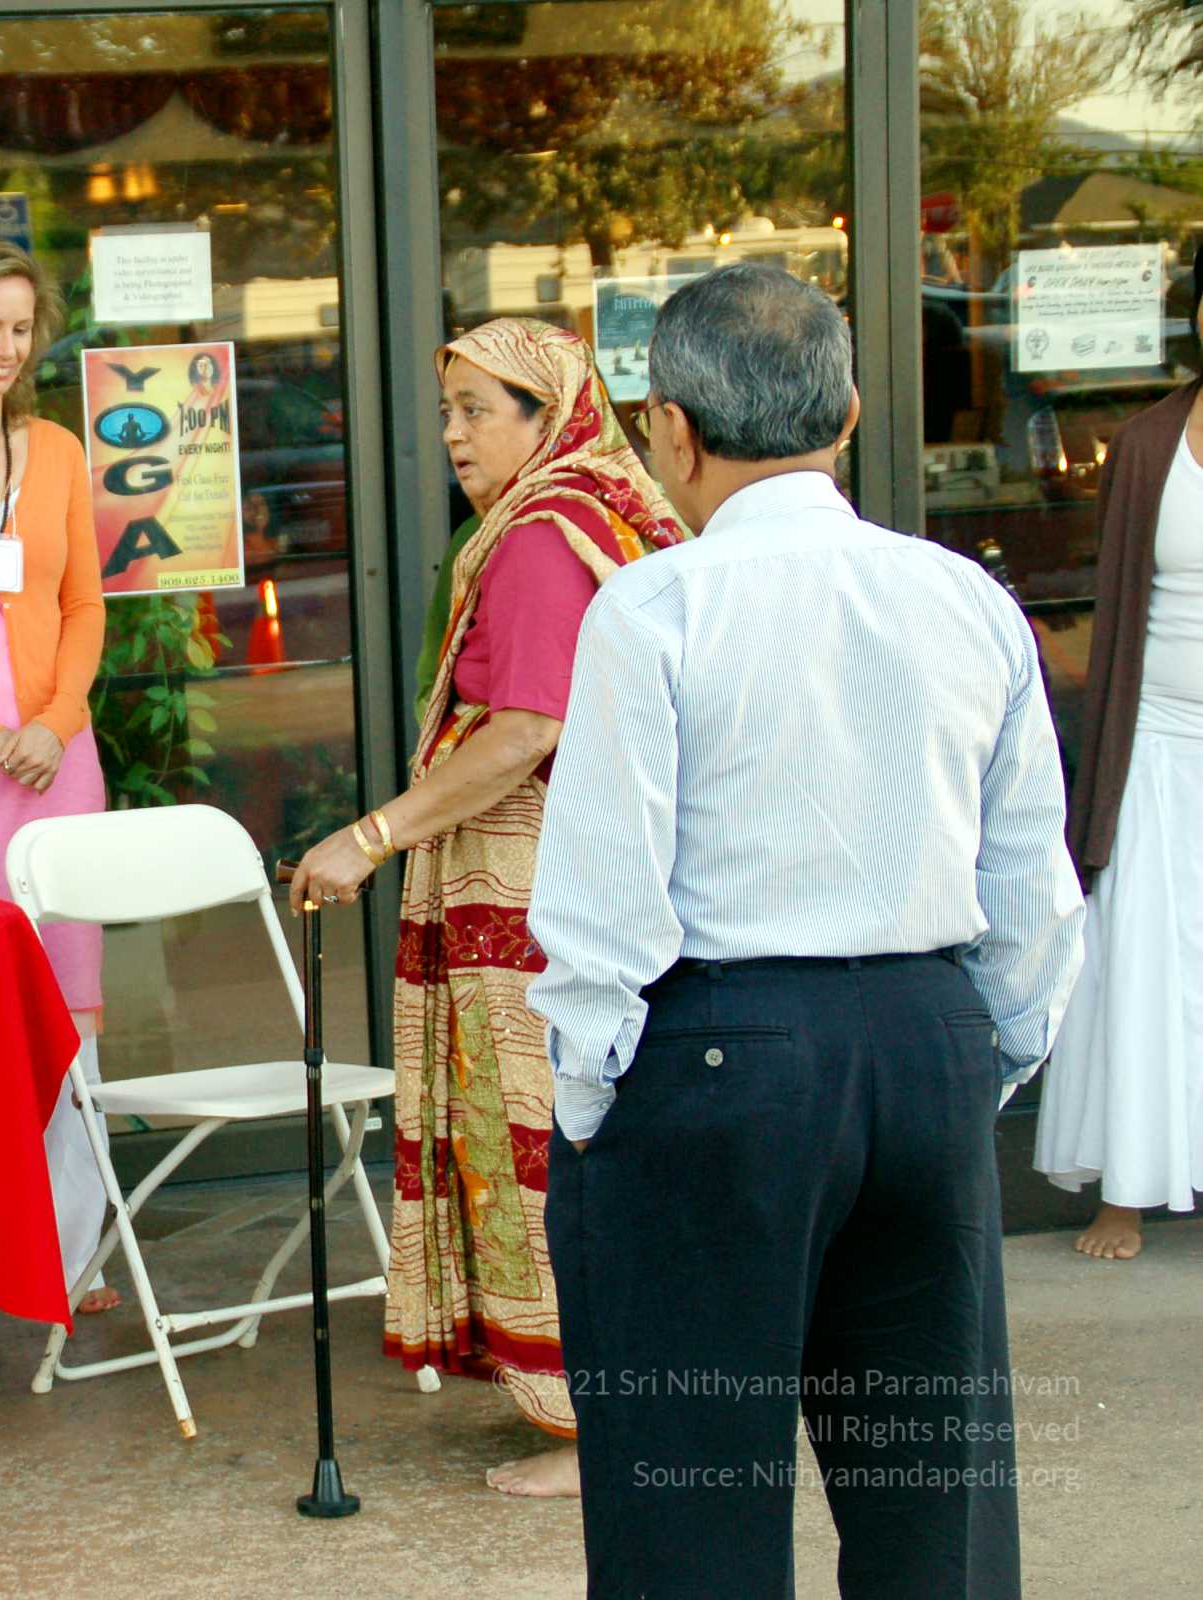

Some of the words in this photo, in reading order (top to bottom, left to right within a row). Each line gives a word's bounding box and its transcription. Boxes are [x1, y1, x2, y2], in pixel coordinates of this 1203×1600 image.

[210, 398, 231, 435] PM
[178, 443, 203, 456] EVERY
[94, 362, 184, 580] YOGA
